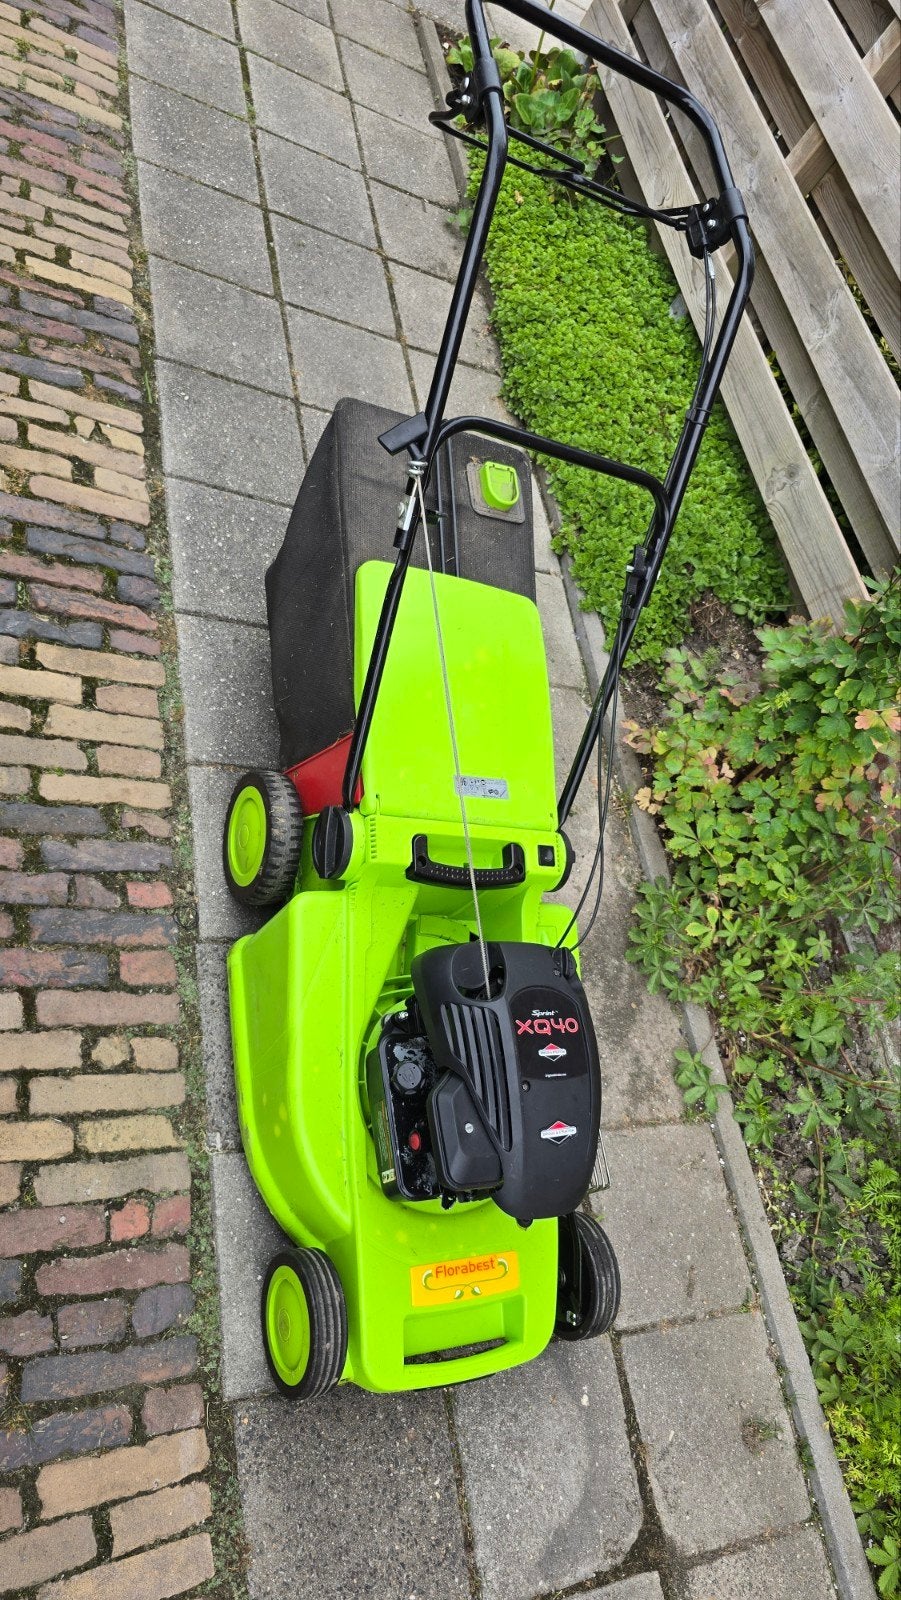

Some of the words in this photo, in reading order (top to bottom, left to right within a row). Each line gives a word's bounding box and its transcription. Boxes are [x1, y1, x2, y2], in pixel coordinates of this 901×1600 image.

[531, 1009, 555, 1017] Sprint
[515, 1018, 579, 1035] XQ40
[435, 1257, 496, 1279] Florabest
